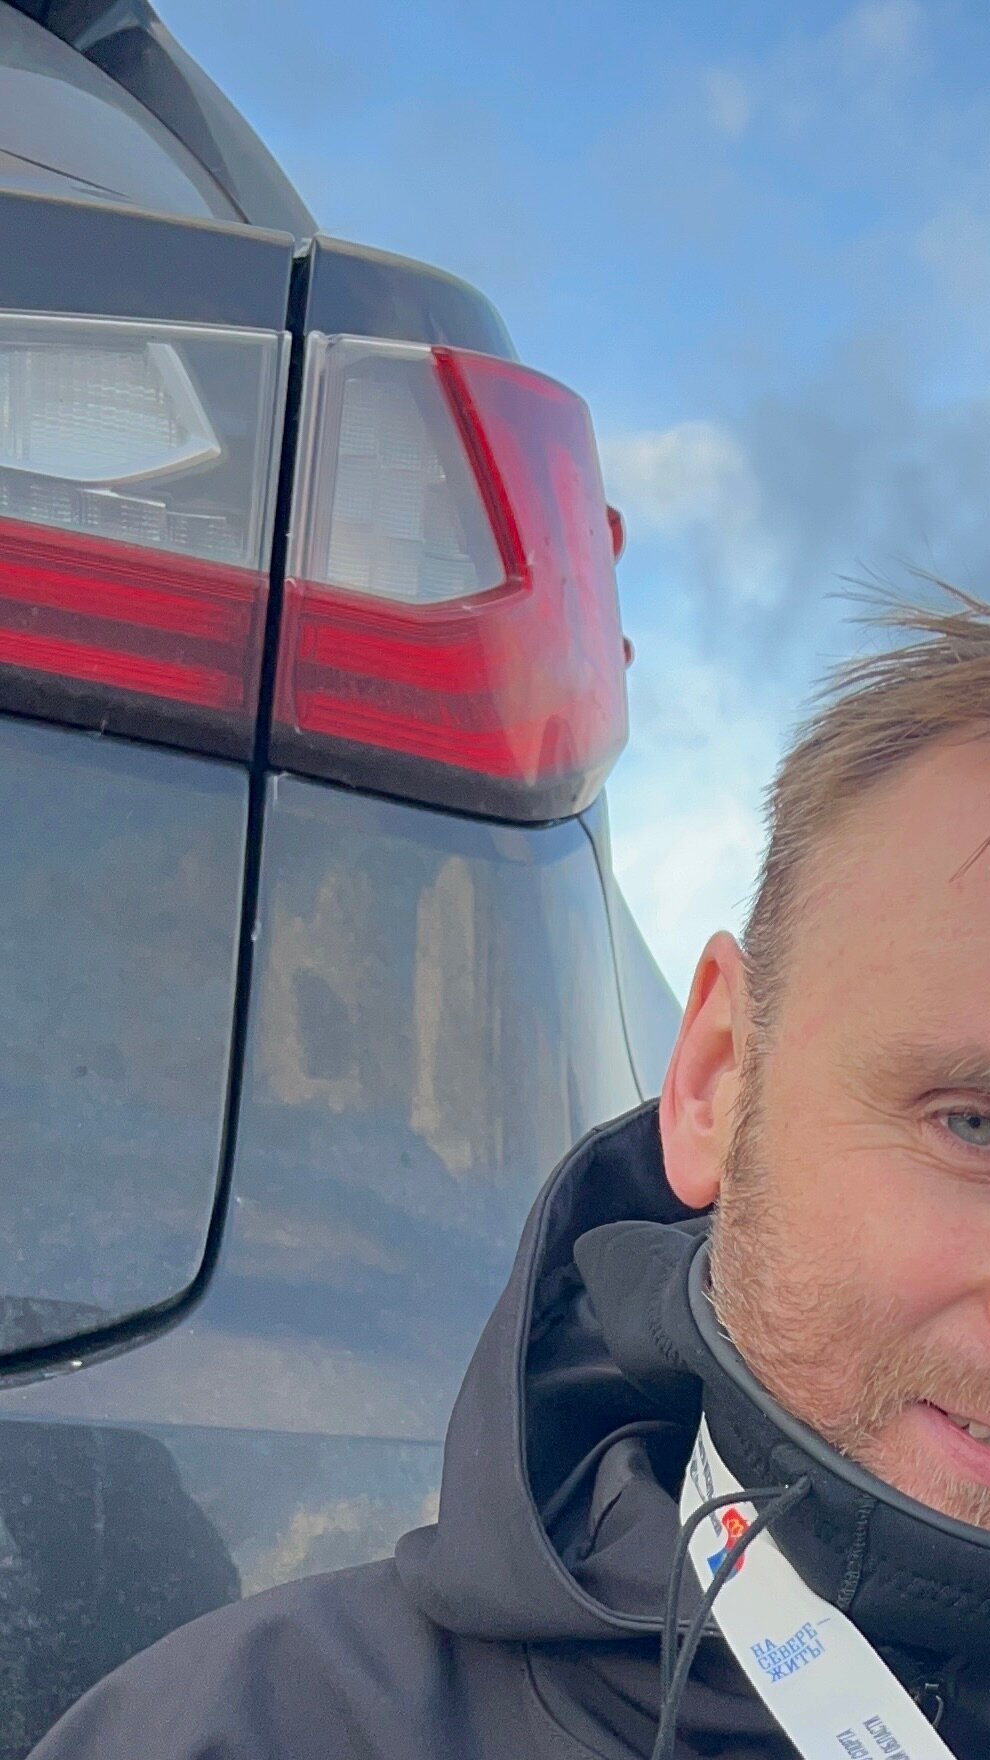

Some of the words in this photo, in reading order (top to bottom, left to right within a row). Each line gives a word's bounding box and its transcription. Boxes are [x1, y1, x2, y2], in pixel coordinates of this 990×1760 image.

[750, 1638, 778, 1658] НА
[757, 1621, 818, 1670] СЕВЕРЕ
[766, 1638, 826, 1683] ЖИТЬ!
[836, 1728, 869, 1760] СПОРТА
[863, 1715, 901, 1754] ОБЛАСТИ
